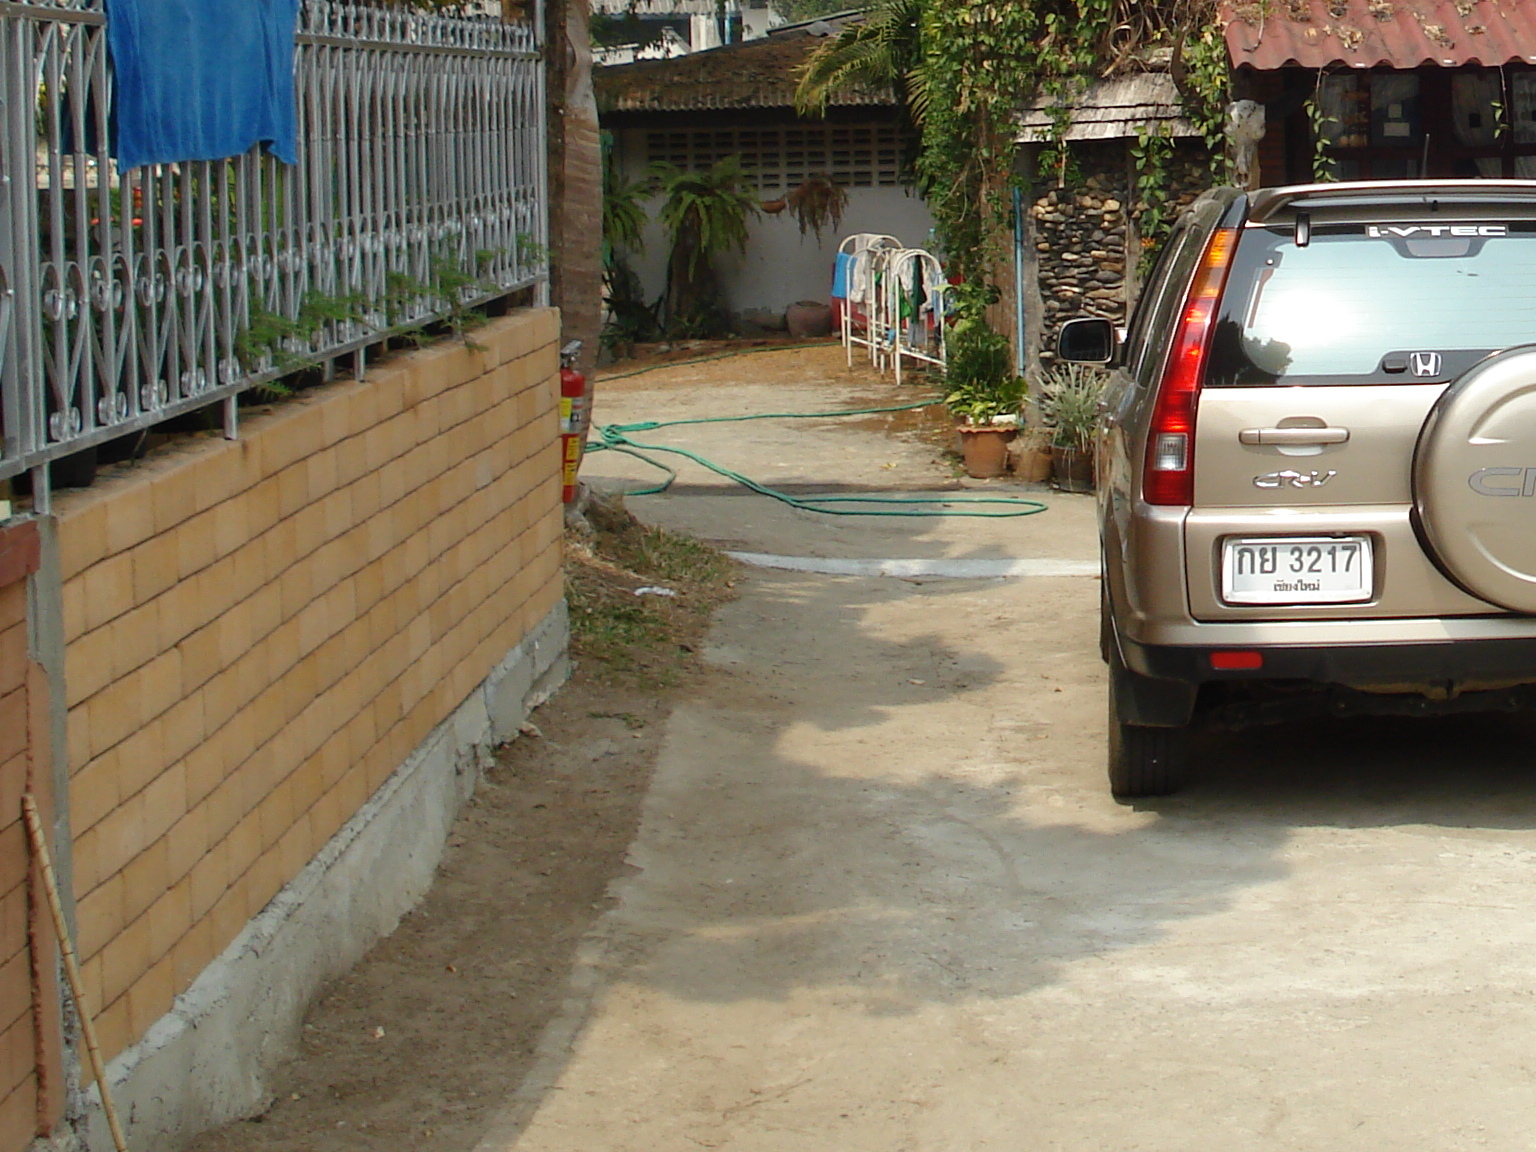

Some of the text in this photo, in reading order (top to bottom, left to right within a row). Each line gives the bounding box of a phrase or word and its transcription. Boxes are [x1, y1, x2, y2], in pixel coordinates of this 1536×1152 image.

[1252, 468, 1338, 489] CR-V
[1236, 544, 1358, 576] กย 3217
[1273, 578, 1321, 592] เชียงใหม่
